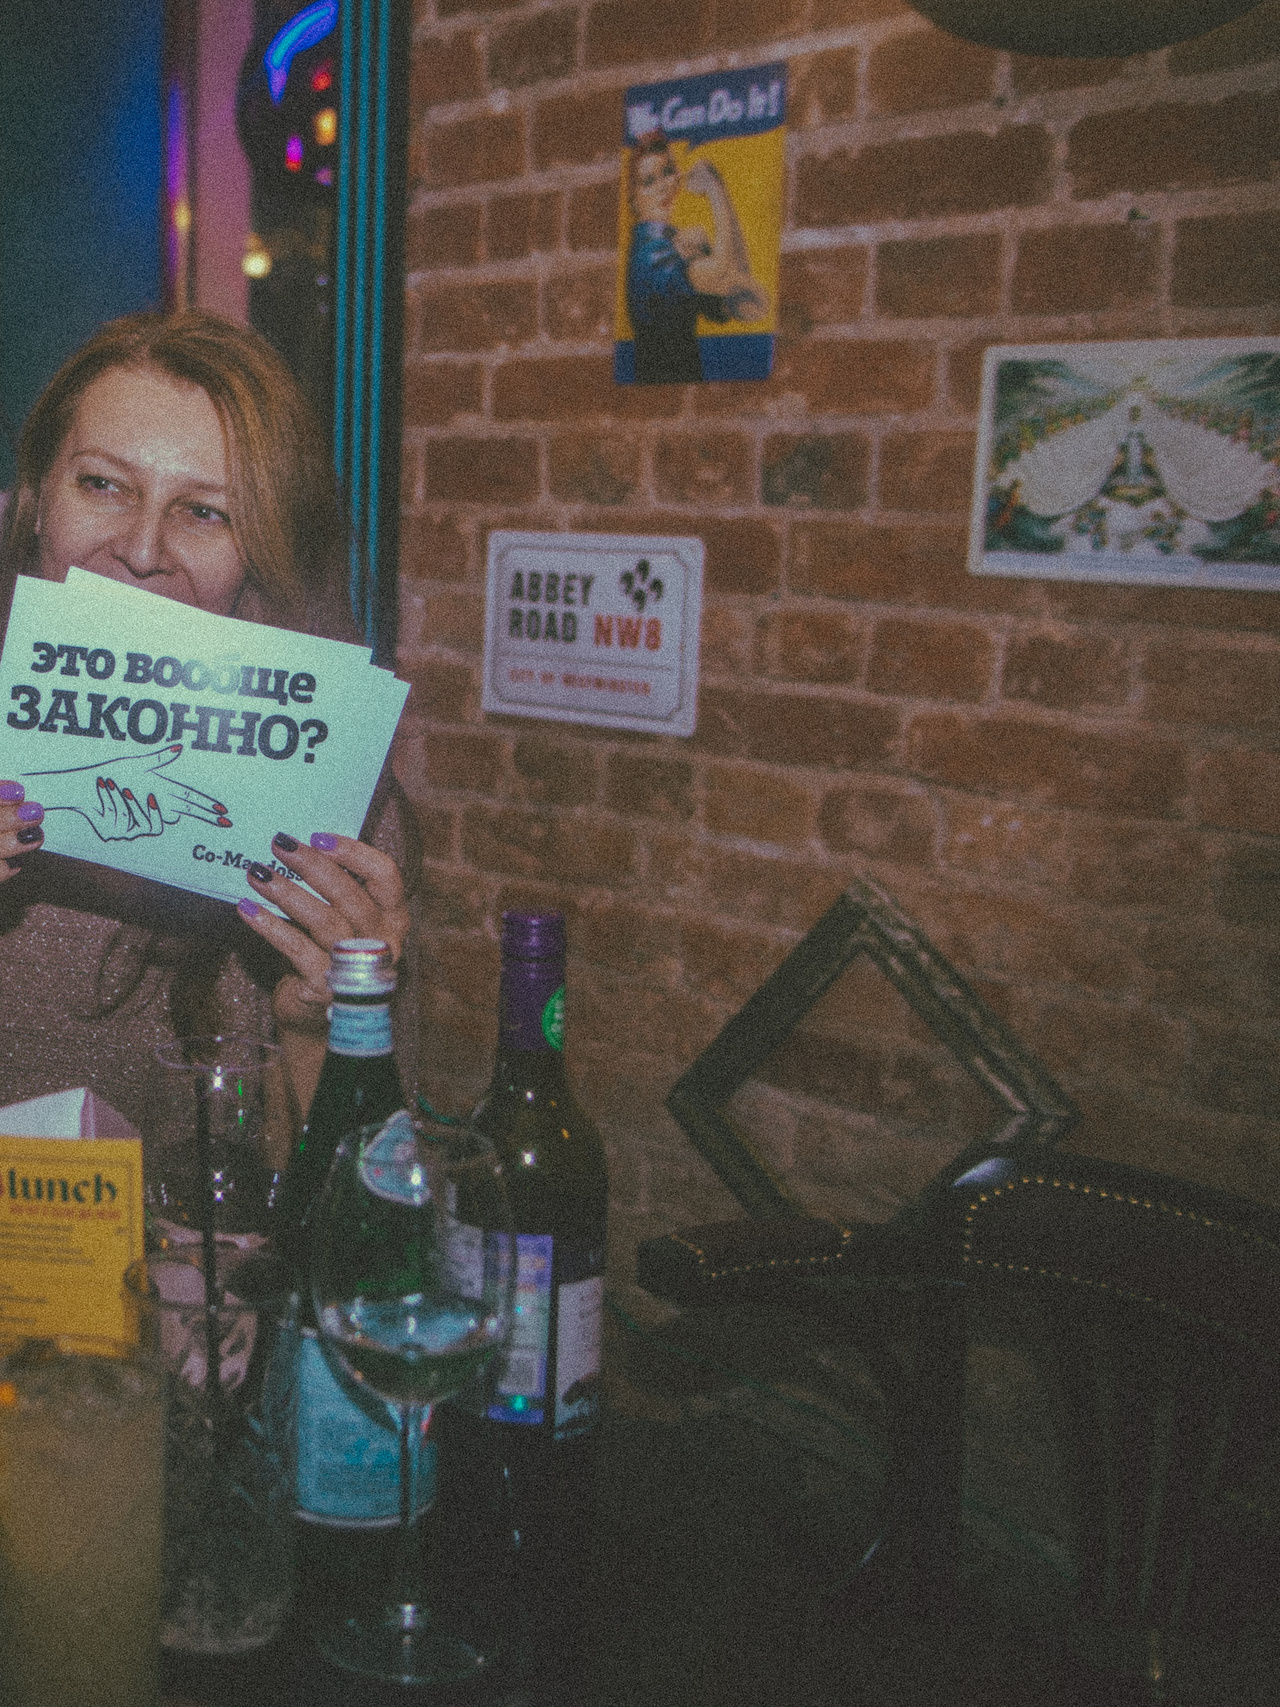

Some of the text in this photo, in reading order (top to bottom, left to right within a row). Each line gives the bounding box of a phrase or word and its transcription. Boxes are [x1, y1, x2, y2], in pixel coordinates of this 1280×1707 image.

[662, 96, 706, 131] Can
[707, 90, 745, 125] Do
[749, 80, 781, 119] It!
[511, 570, 594, 606] ABBEY
[509, 607, 662, 651] ROAD NW8
[123, 651, 317, 706] вообще
[6, 684, 328, 763] ЗАКОННО?
[8, 1168, 118, 1204] lunch
